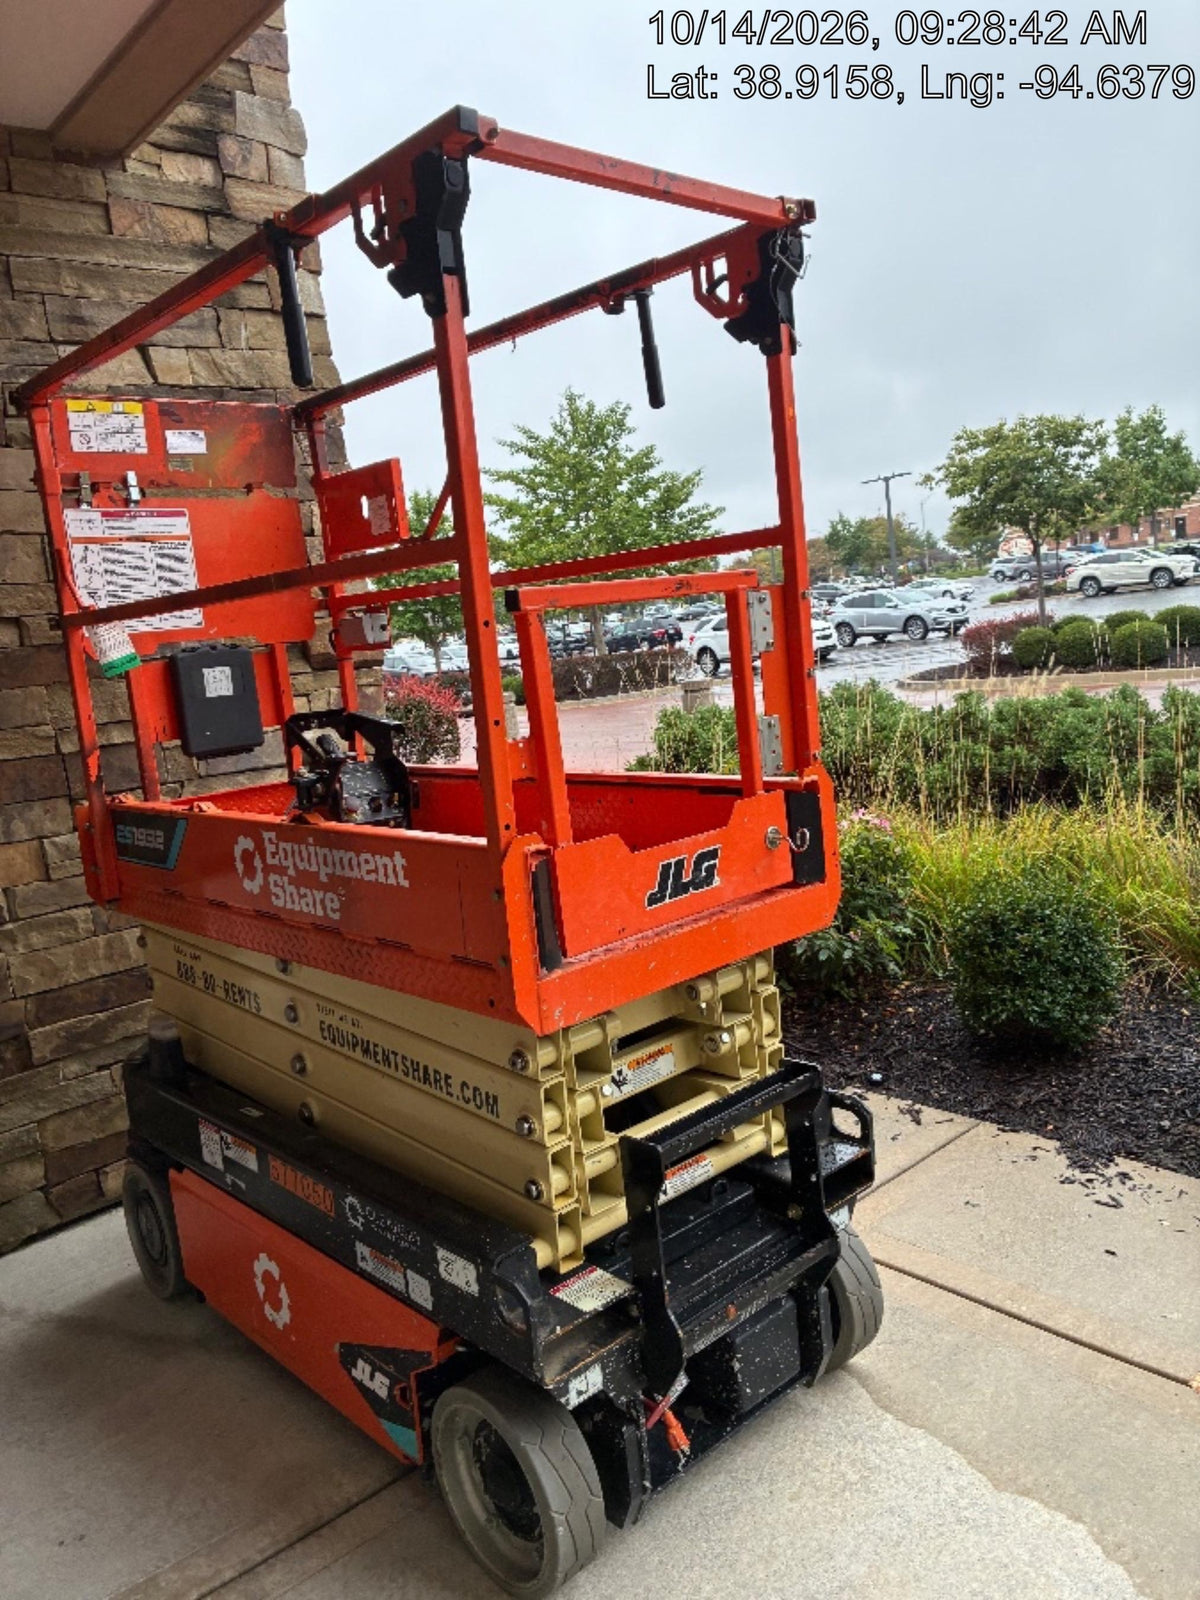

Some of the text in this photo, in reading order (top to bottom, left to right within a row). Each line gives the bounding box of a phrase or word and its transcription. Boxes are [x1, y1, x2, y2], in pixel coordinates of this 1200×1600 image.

[262, 830, 411, 888] Equipment
[644, 844, 722, 911] JLG
[268, 874, 341, 920] Share
[319, 1020, 501, 1120] EQUIPMENTSHARE.COM
